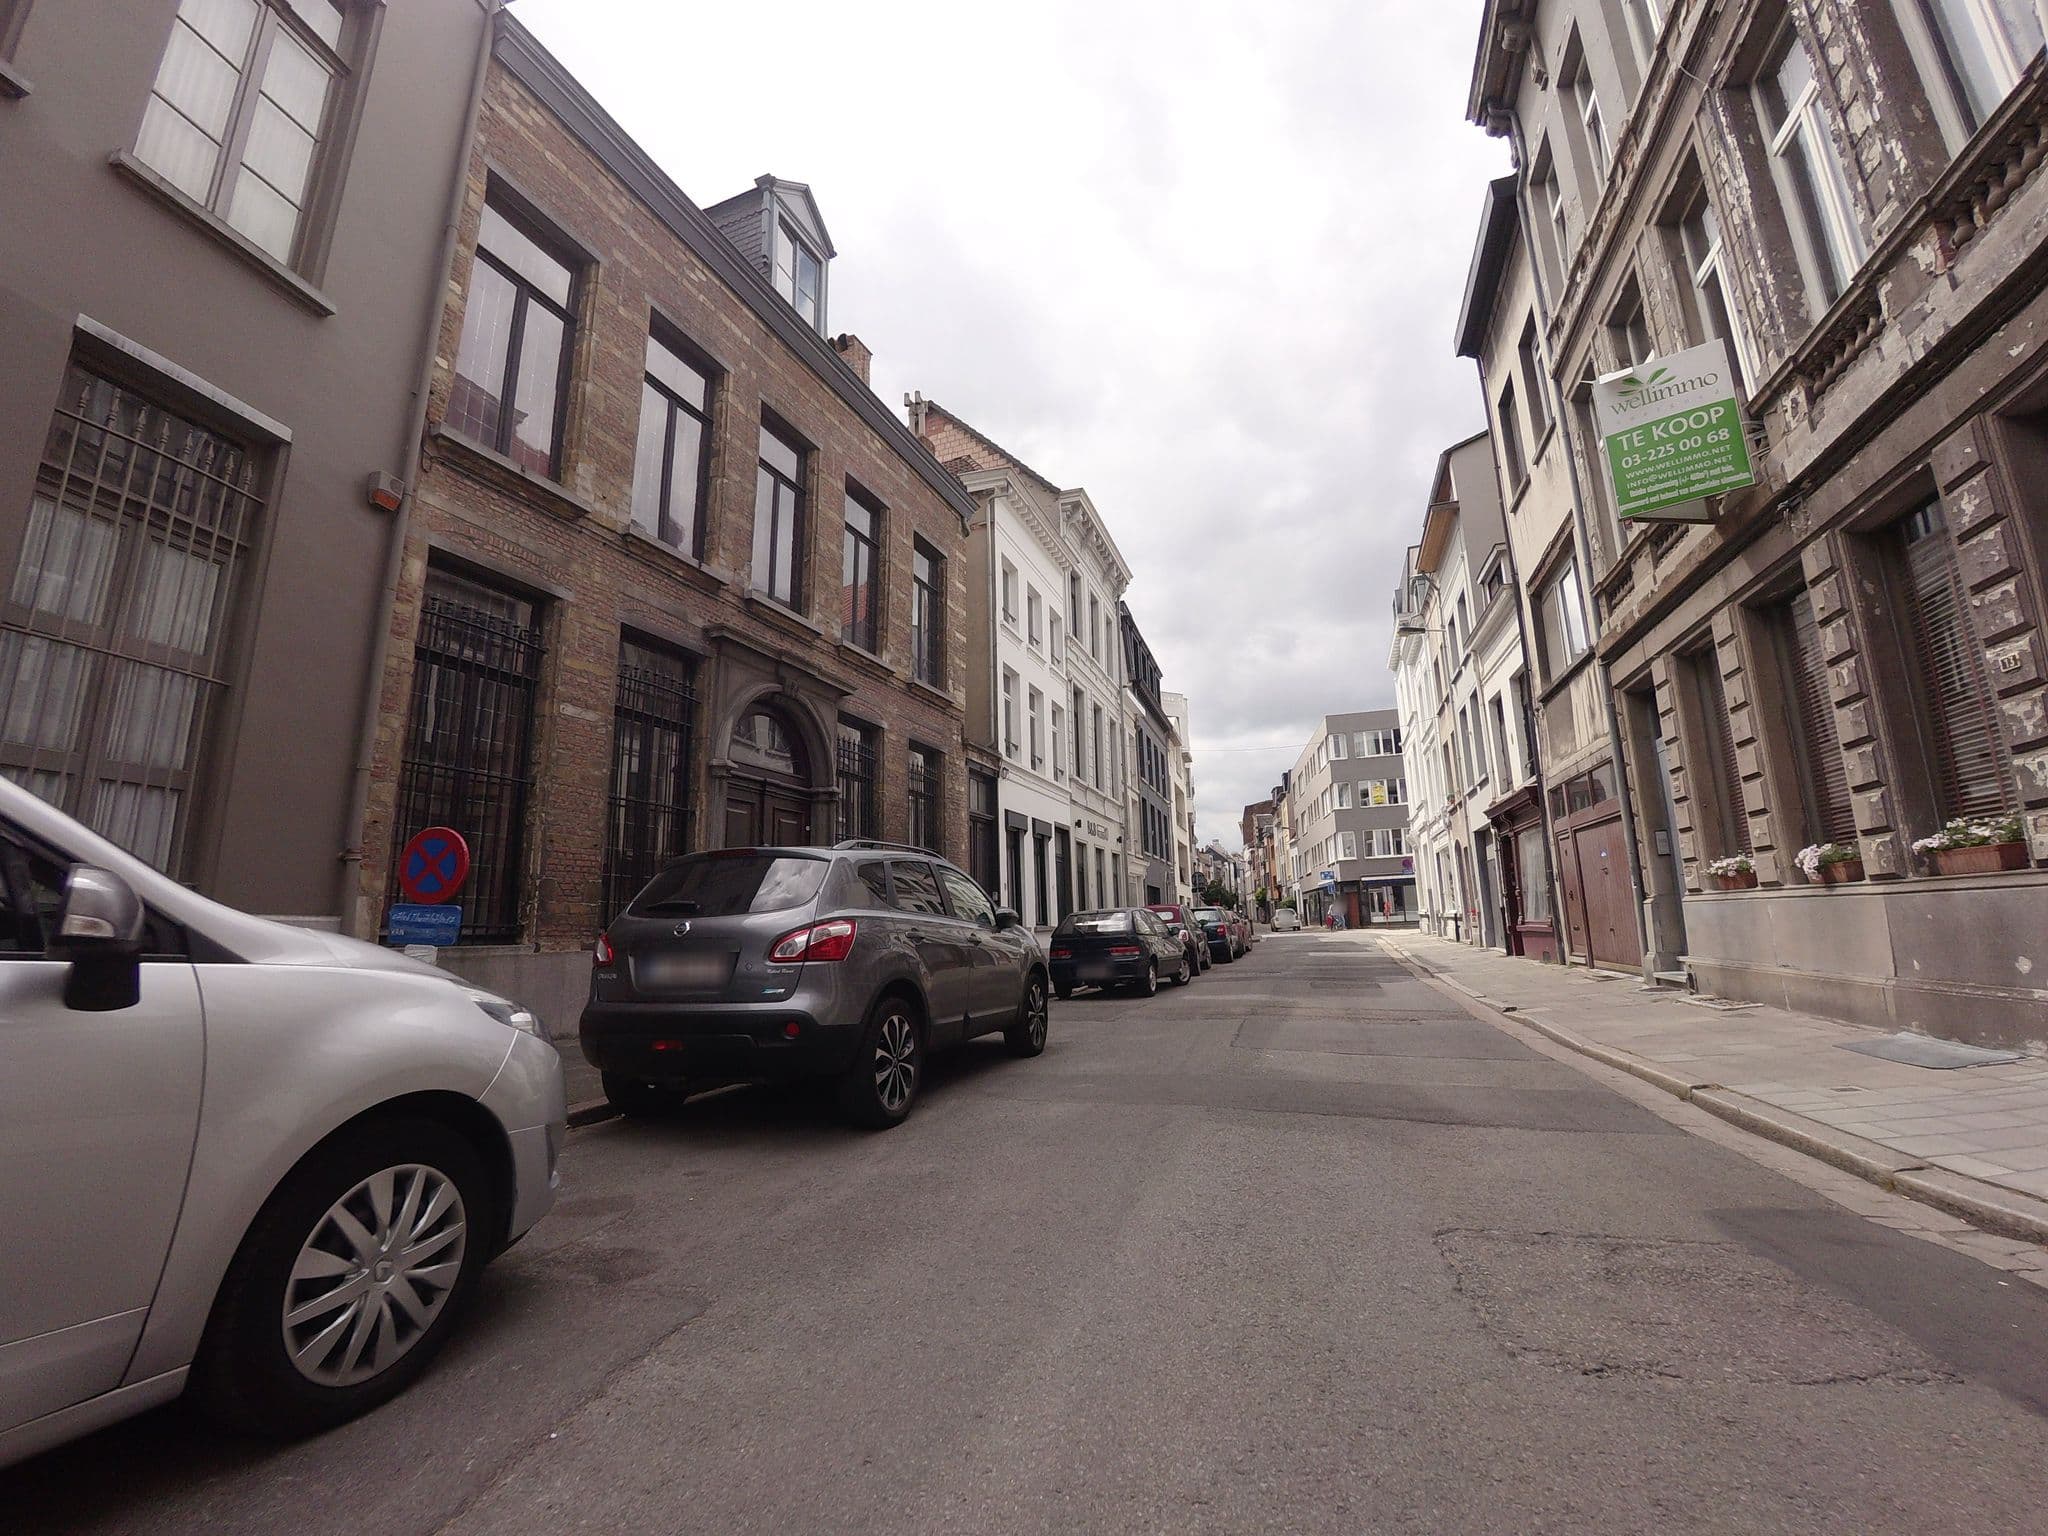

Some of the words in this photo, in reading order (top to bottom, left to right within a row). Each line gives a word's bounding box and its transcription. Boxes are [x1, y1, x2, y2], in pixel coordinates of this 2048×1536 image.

[1610, 372, 1718, 415] wellimmo
[1617, 430, 1645, 451] TE
[1652, 406, 1725, 440] KOOP
[1622, 443, 1675, 468] 03-225
[1679, 436, 1701, 451] 00
[1707, 428, 1730, 443] 68
[1625, 444, 1731, 479] WWW.WELLIMMO.NET
[1627, 455, 1733, 489] INFO@WELLIMMO.NET
